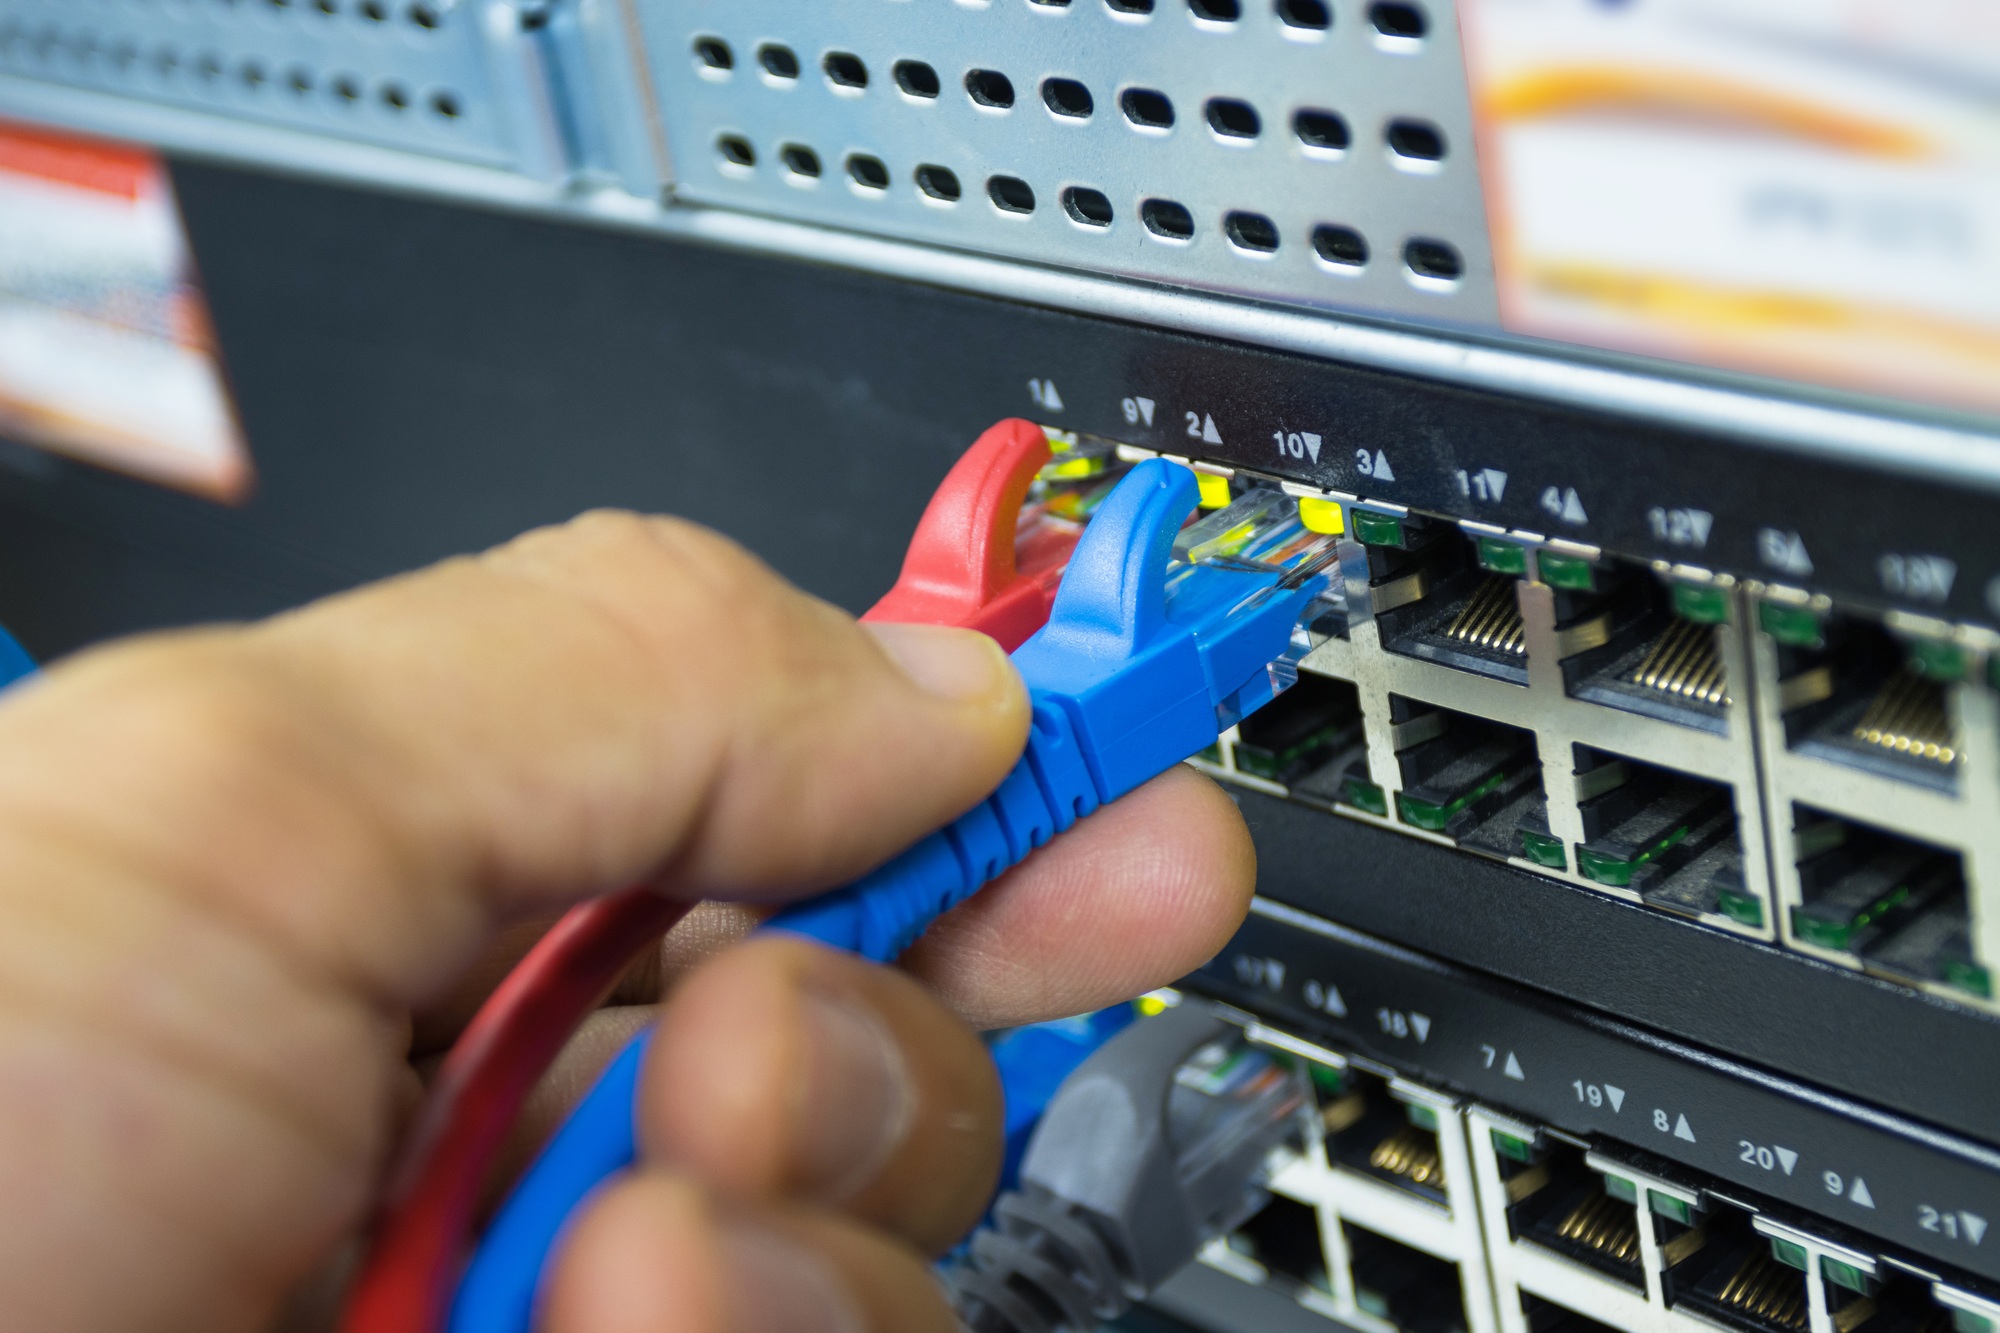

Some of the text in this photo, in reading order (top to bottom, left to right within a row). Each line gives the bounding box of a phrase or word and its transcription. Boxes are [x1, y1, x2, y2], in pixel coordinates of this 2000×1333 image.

[1028, 378, 1044, 402] 1
[1122, 398, 1138, 424] 9
[1186, 411, 1202, 437] 2
[1274, 430, 1304, 459] 10
[1356, 449, 1372, 474] 3
[1456, 469, 1488, 500] 11
[1543, 487, 1563, 514] 4
[1648, 506, 1692, 544] 12
[1480, 1043, 1496, 1069] 7
[1573, 1079, 1602, 1108] 19
[1653, 1109, 1669, 1132] 8
[1739, 1140, 1774, 1171] 20
[1823, 1170, 1843, 1196] 9
[1918, 1204, 1957, 1239] 21
